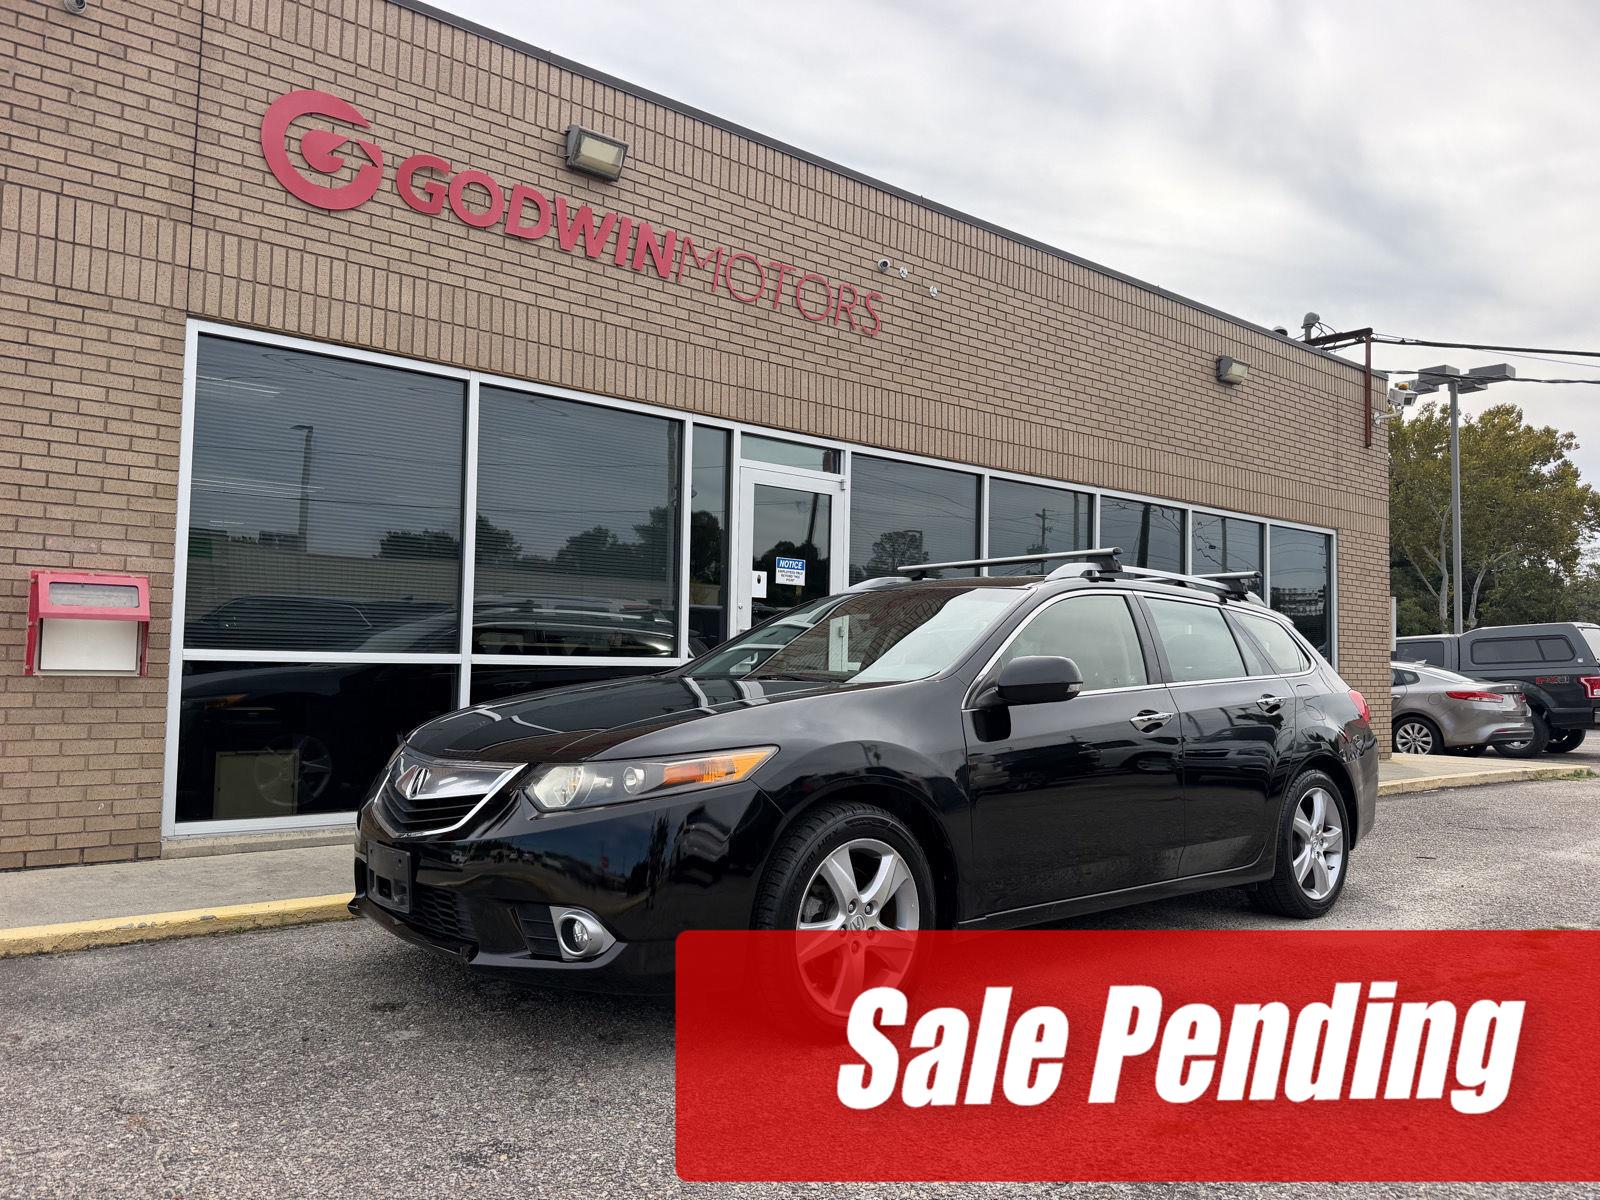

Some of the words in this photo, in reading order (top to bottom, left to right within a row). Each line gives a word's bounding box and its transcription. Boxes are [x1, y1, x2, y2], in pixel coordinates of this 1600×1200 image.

[396, 153, 679, 279] GODWIN
[677, 236, 884, 336] MOTORS
[779, 560, 803, 569] NOTICE
